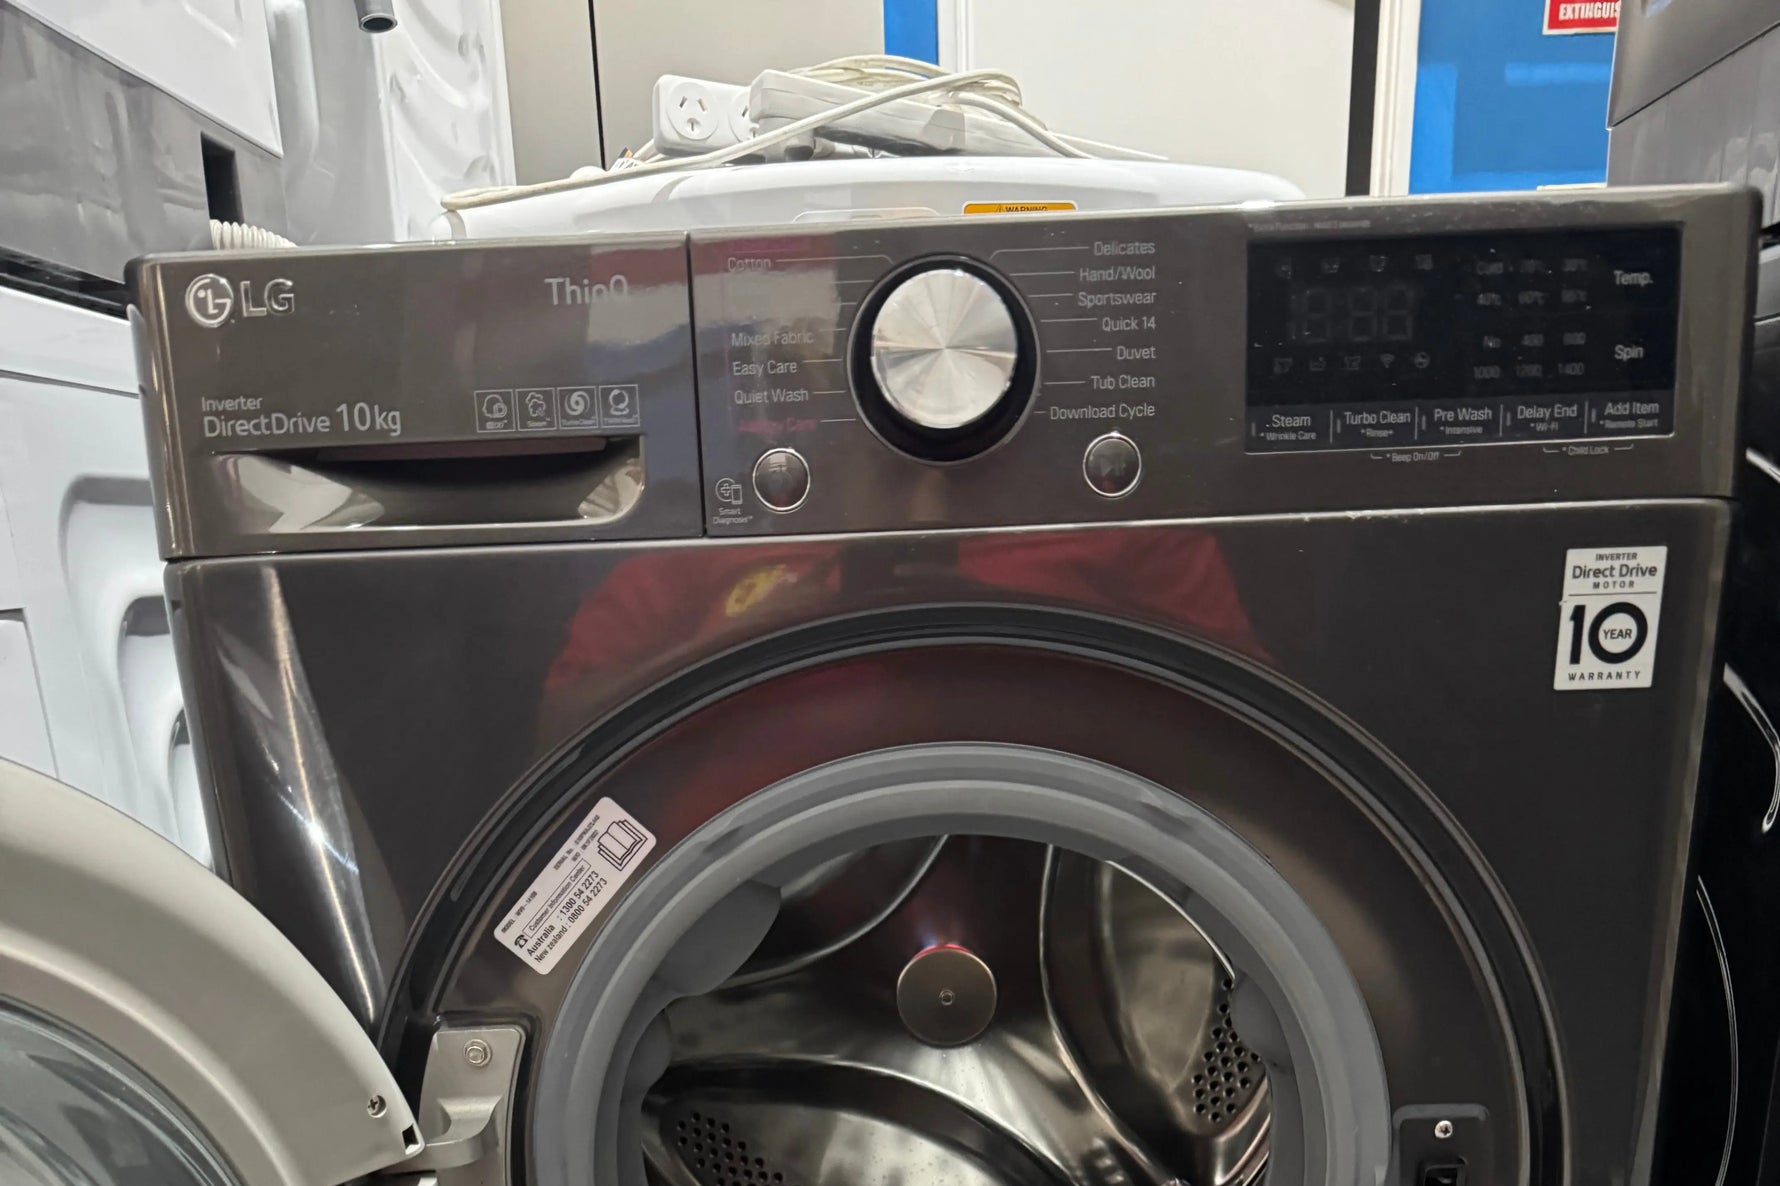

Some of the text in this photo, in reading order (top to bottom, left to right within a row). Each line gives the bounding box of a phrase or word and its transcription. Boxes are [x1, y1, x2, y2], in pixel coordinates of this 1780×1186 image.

[1094, 241, 1156, 255] Delicates
[727, 256, 772, 272] Cotton
[1079, 265, 1155, 281] Hand/Wool
[1614, 269, 1653, 287] Temp.
[239, 278, 296, 317] LG
[1078, 291, 1157, 309] Sportswear
[1102, 316, 1156, 331] Quick 14
[1116, 345, 1156, 360] Duvet
[1614, 344, 1644, 361] Spin
[733, 360, 798, 377] Easy Care
[1091, 374, 1155, 389] Tub Clean
[201, 396, 263, 412] Inverter
[734, 388, 809, 404] Quiet Wash
[1050, 402, 1156, 420] Download Cycle
[1434, 407, 1492, 421] Pre Wash
[1517, 404, 1578, 420] Delay End
[1604, 401, 1660, 416] Add Item
[1271, 414, 1312, 428] Steam
[1344, 410, 1411, 425] Turbo Clean
[1595, 552, 1638, 561] INVERTER
[1572, 563, 1658, 579] Direct Drive
[1592, 580, 1635, 590] MOTOR
[1569, 601, 1648, 664] 10
[1603, 628, 1632, 640] YEAR
[1568, 670, 1641, 681] WARRANTY
[528, 864, 585, 931] Customer Information Center
[525, 922, 555, 956] Australia
[558, 897, 576, 916] 1300
[573, 888, 584, 899] 54
[581, 870, 599, 889] 2273
[534, 947, 548, 962] New
[545, 924, 567, 950] zealand
[567, 904, 585, 923] 0800
[581, 895, 592, 906] 54
[589, 877, 607, 896] 2273
